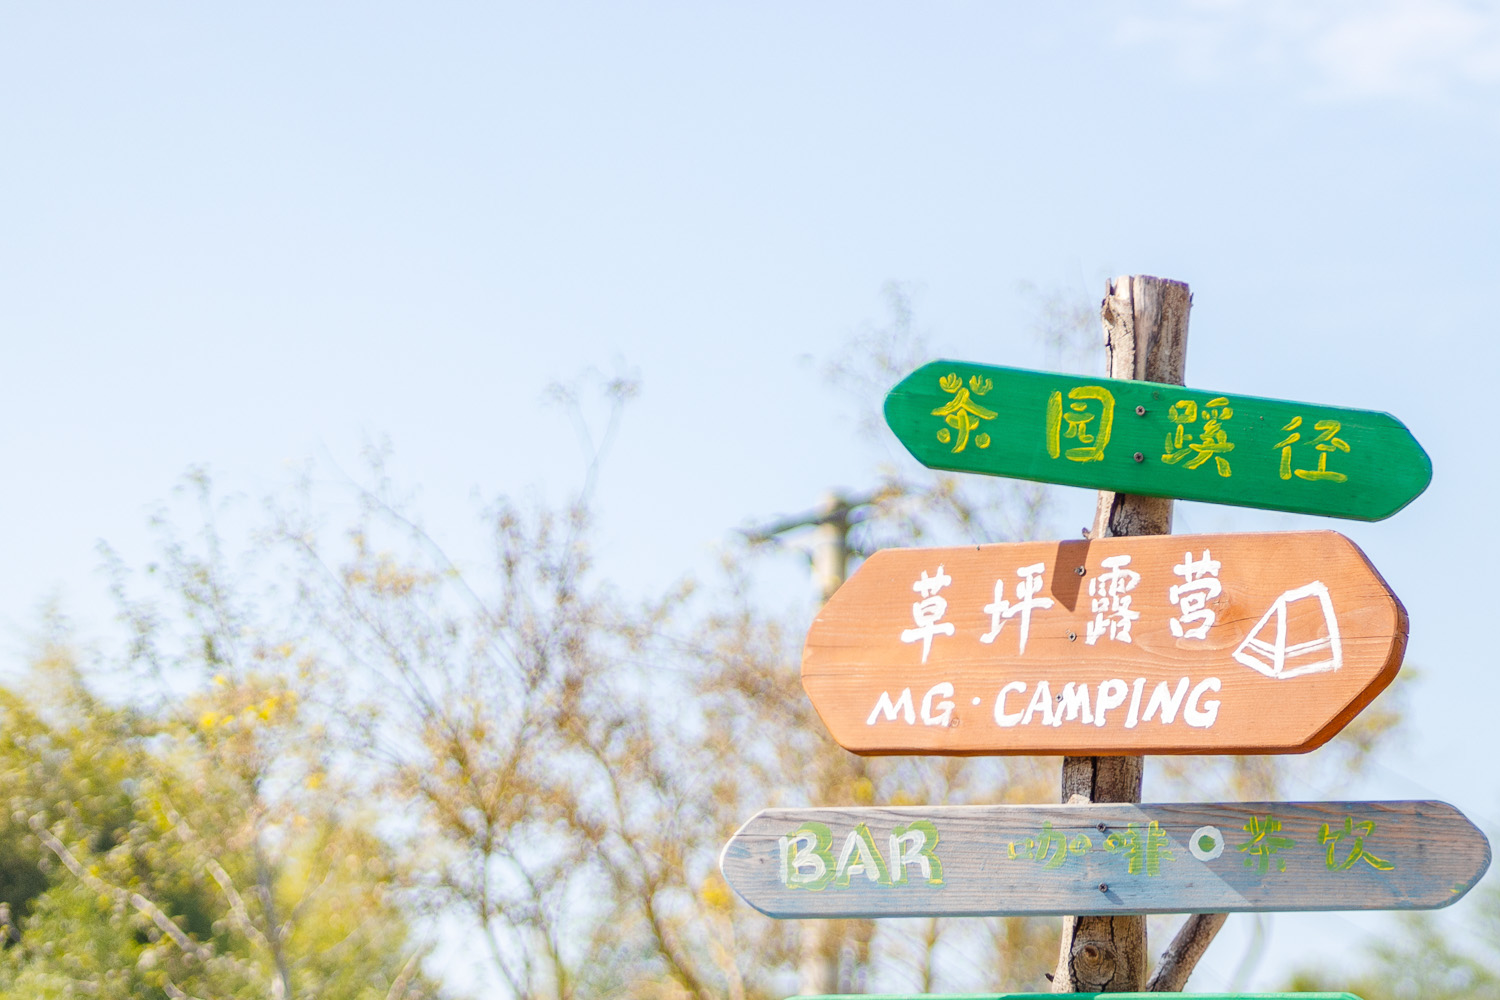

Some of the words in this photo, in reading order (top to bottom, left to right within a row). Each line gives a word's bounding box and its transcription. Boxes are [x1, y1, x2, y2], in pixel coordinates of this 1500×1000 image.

[901, 550, 1222, 663] 草坪露营
[779, 820, 946, 891] BAR
